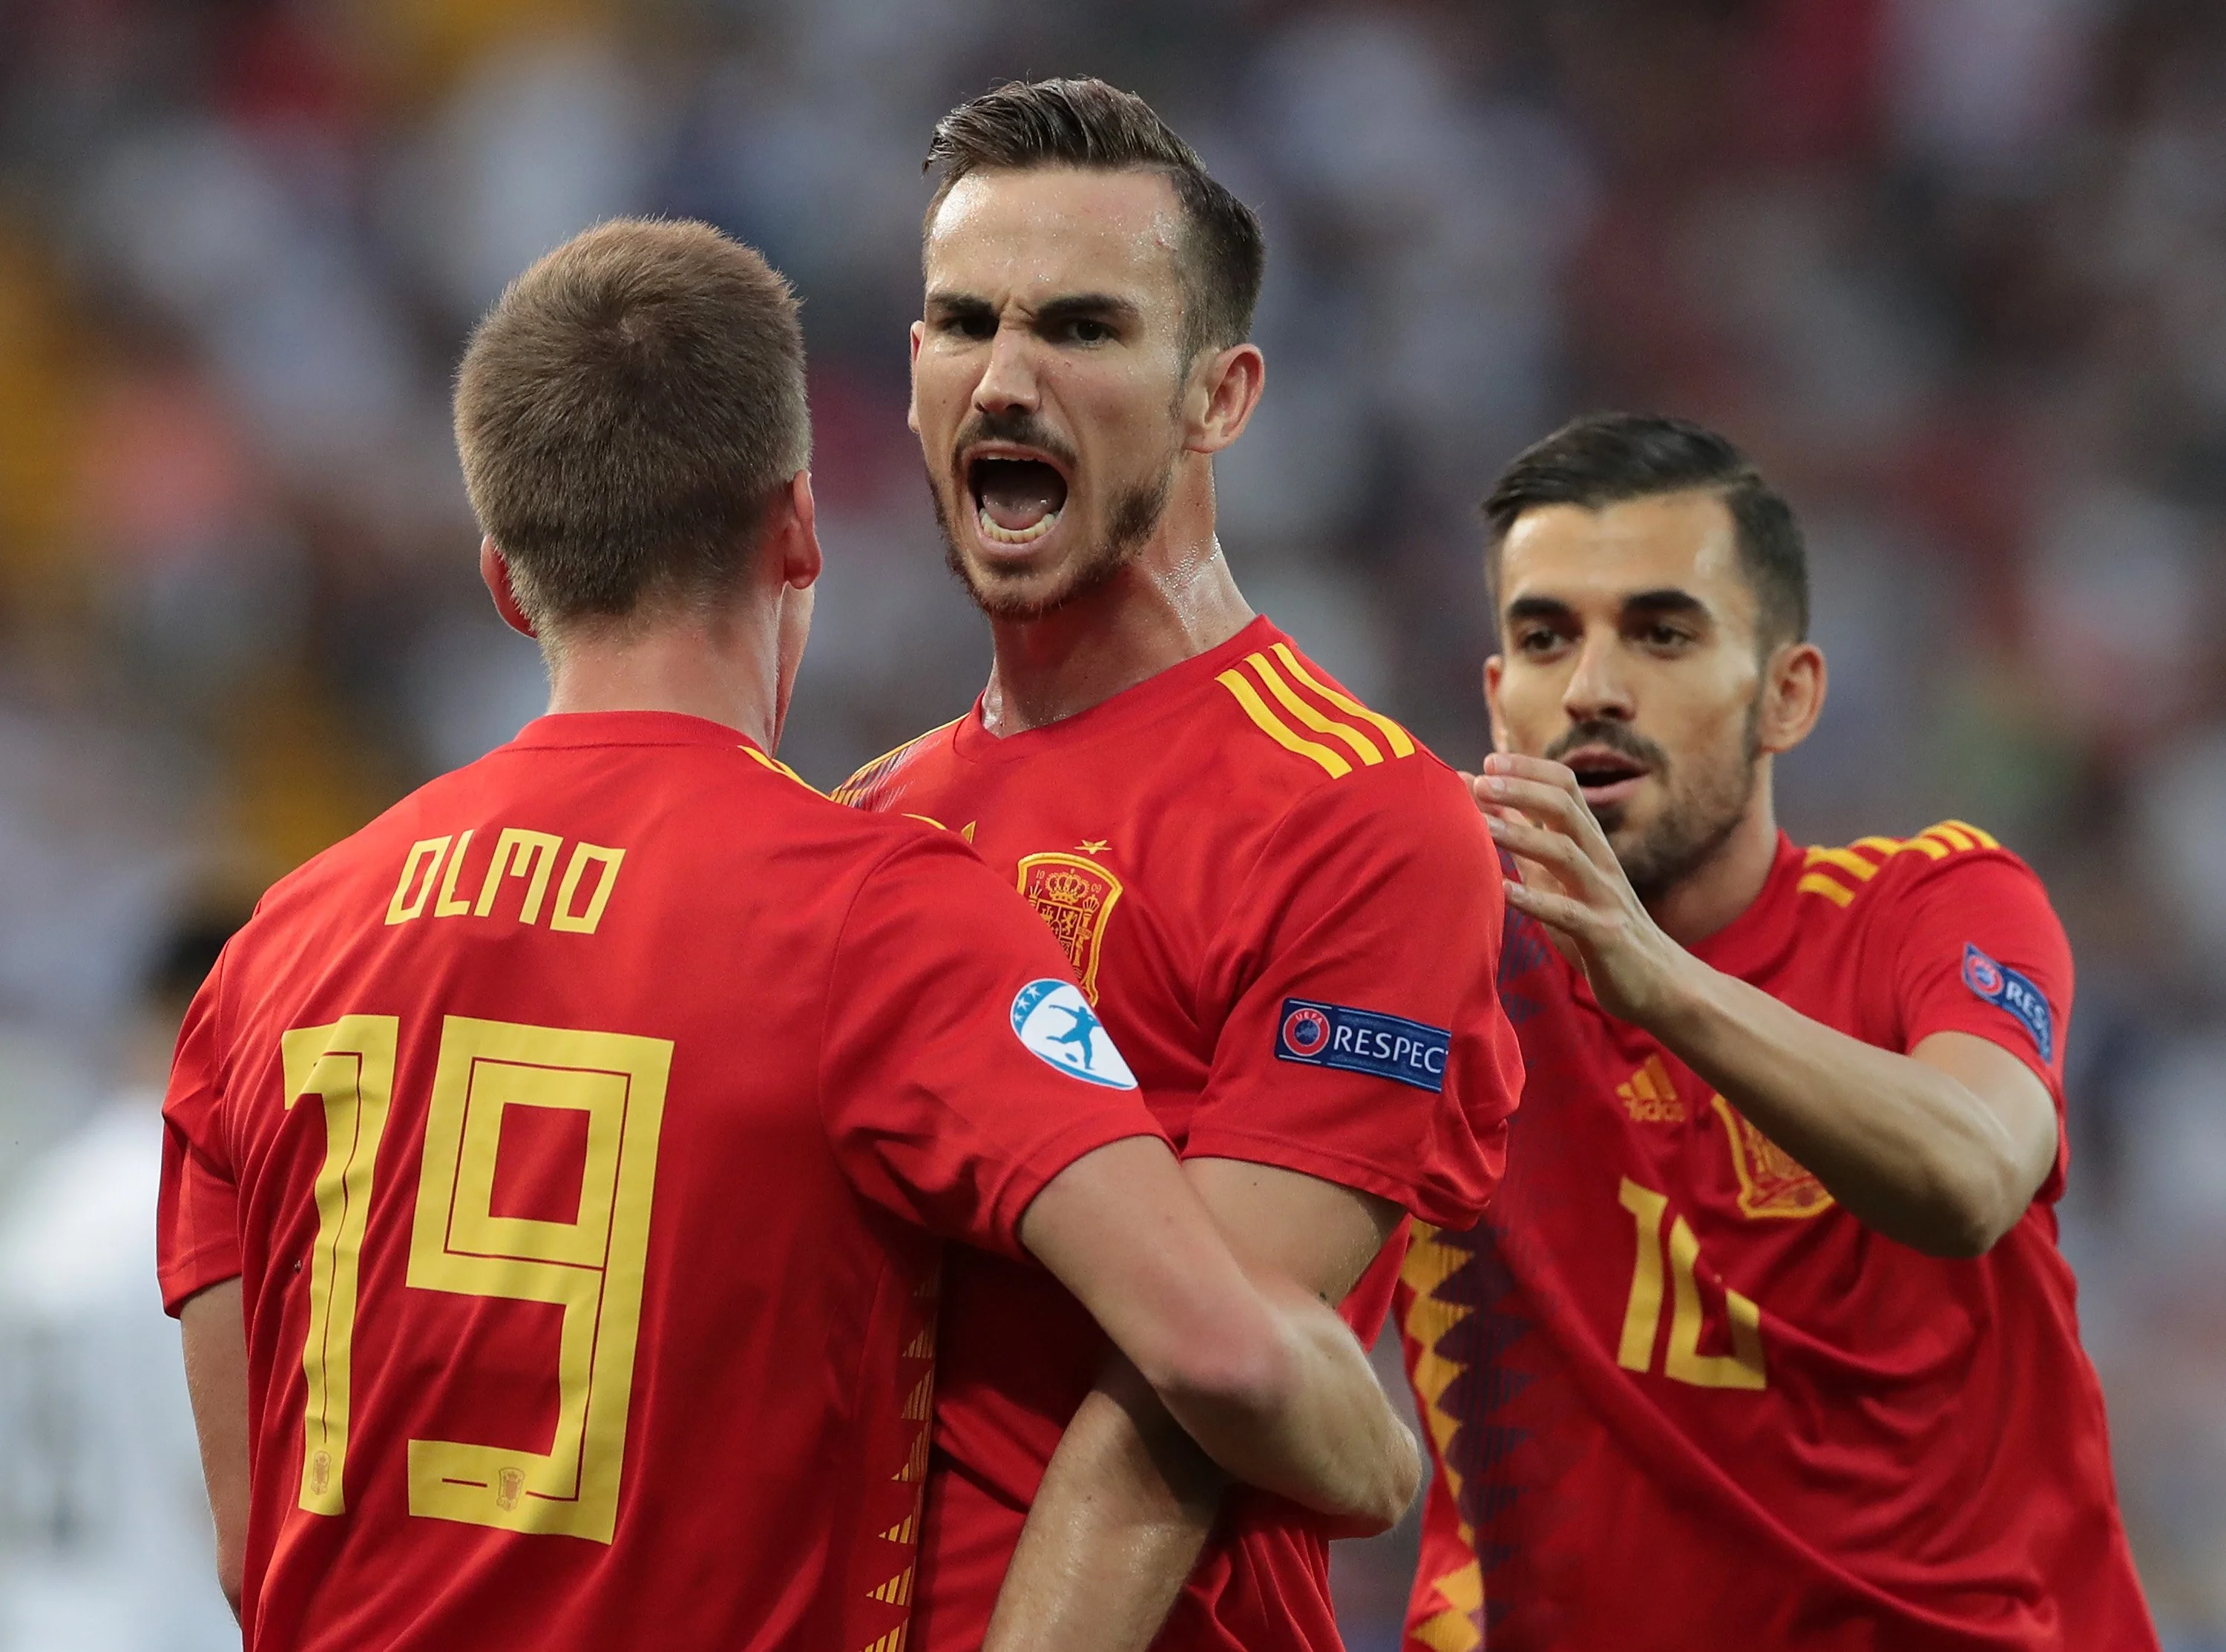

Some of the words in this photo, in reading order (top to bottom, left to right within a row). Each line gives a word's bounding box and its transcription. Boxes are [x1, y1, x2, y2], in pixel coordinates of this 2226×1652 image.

[384, 827, 626, 934] OLMO
[1295, 1011, 1323, 1024] UEFA
[1333, 1025, 1449, 1073] RESPEC
[281, 1014, 675, 1545] 19
